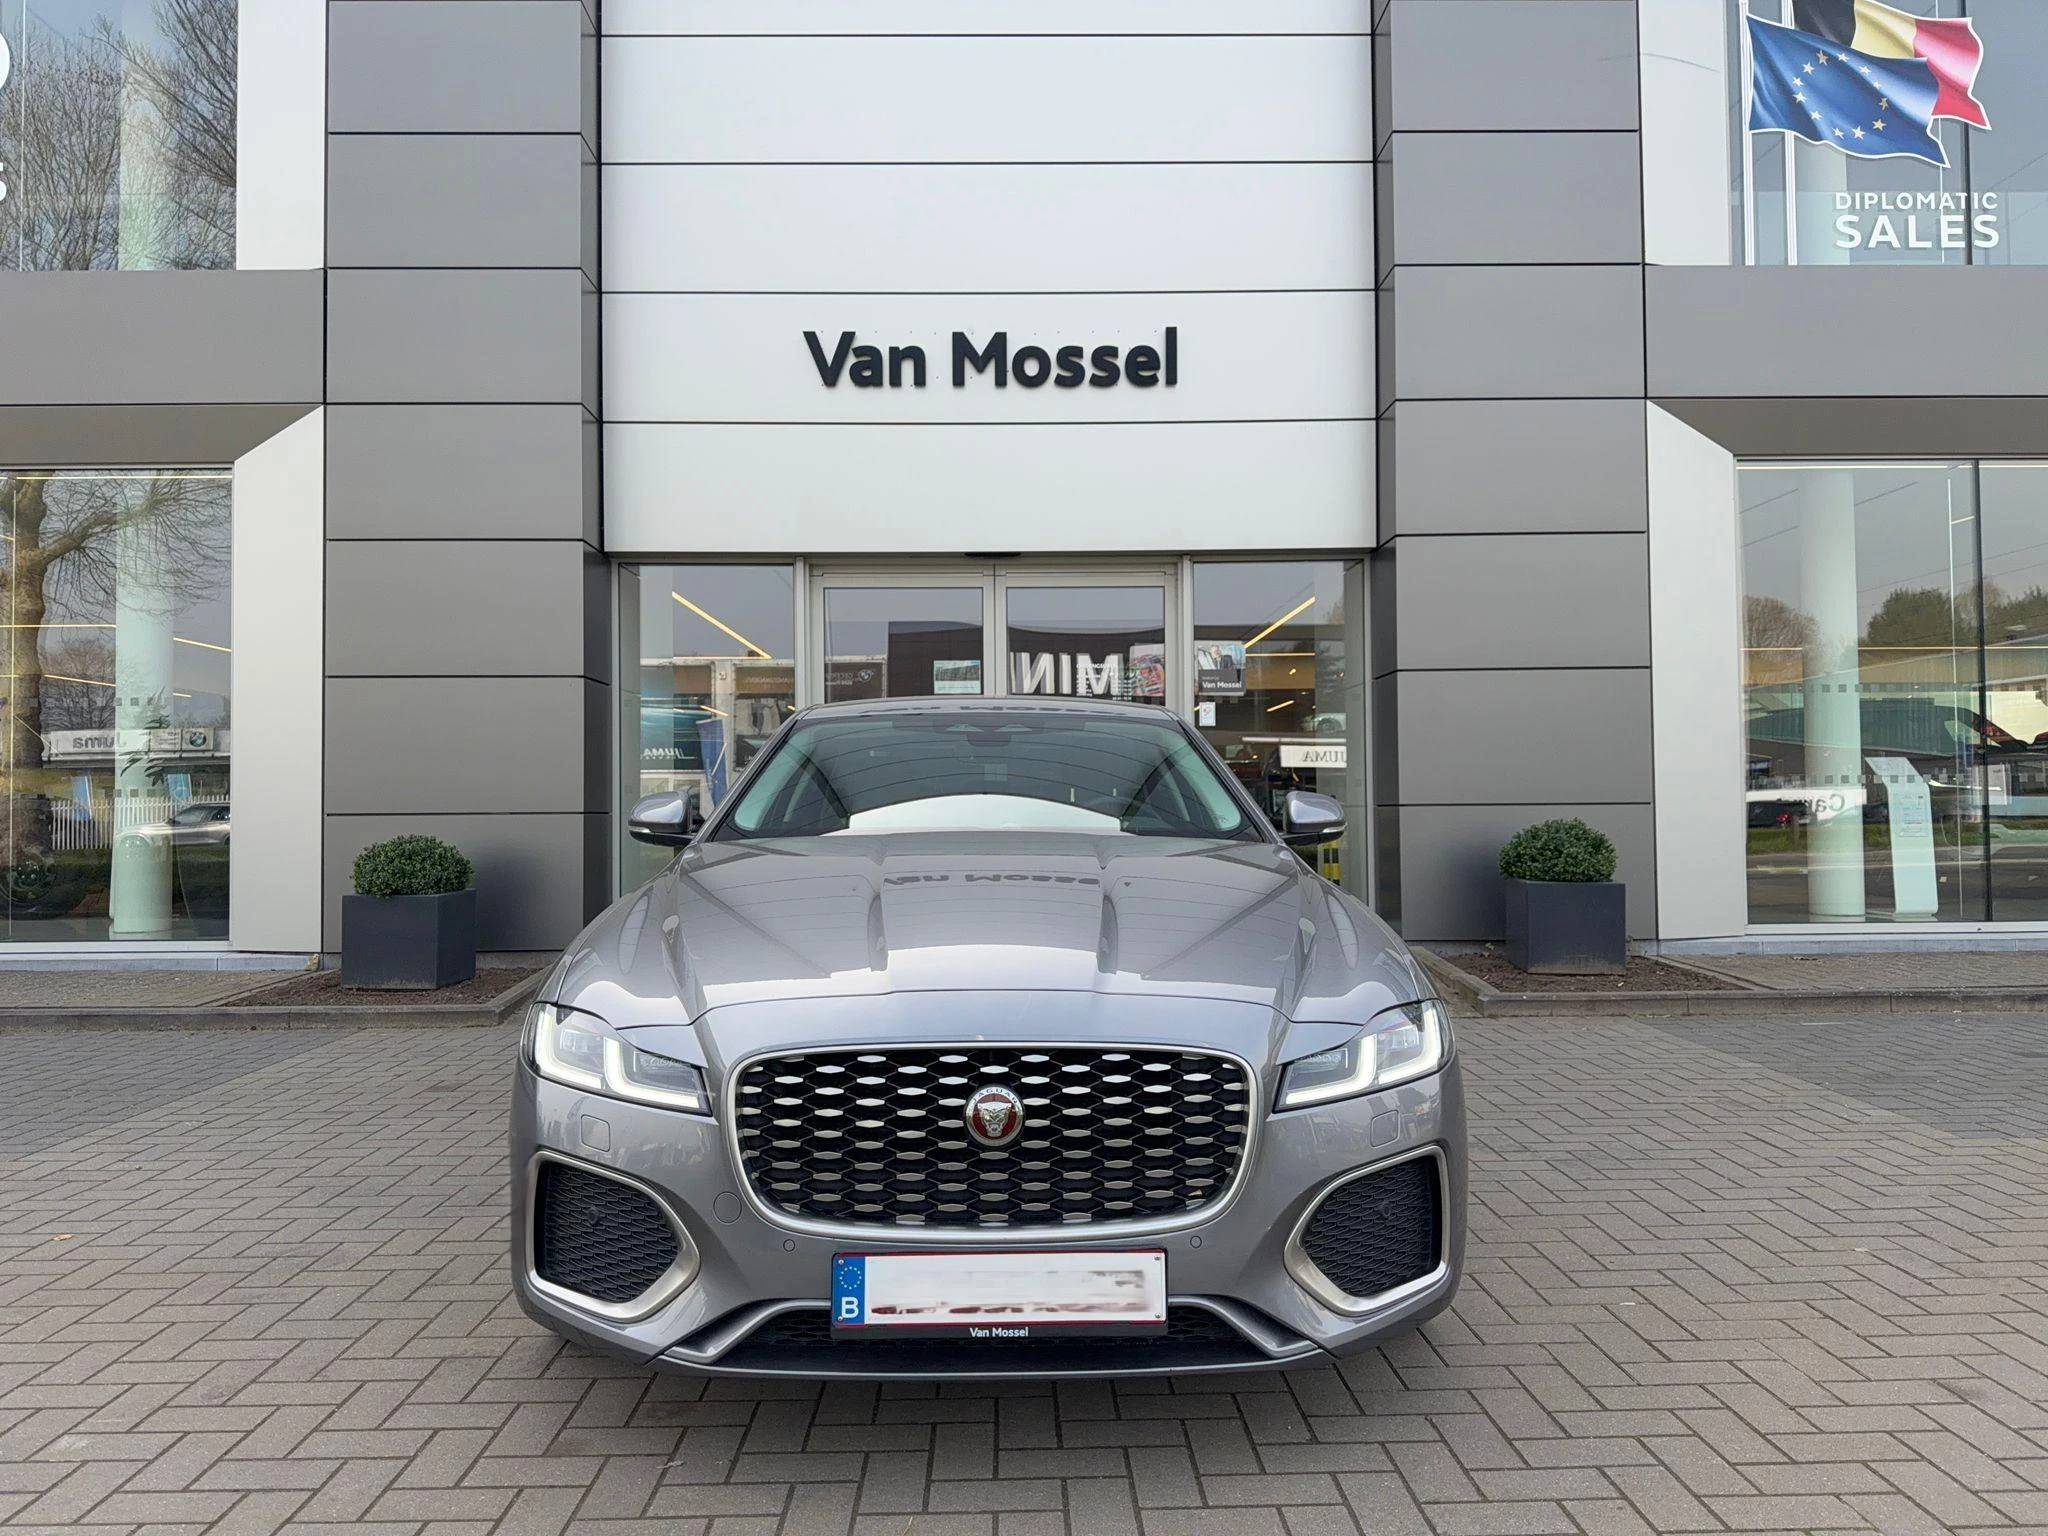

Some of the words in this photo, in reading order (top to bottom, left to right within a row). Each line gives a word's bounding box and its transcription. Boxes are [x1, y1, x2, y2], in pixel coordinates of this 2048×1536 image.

[1835, 192, 1999, 210] DIPLOMATIC
[1835, 214, 2000, 249] SALES
[802, 331, 926, 388] Van
[952, 326, 1178, 388] Mossel
[1202, 681, 1216, 689] Van
[1217, 680, 1242, 689] Mossel
[973, 1088, 1019, 1104] JAGUAR
[841, 1297, 859, 1319] B
[969, 1327, 990, 1338] Van
[992, 1326, 1029, 1338] Mossel
